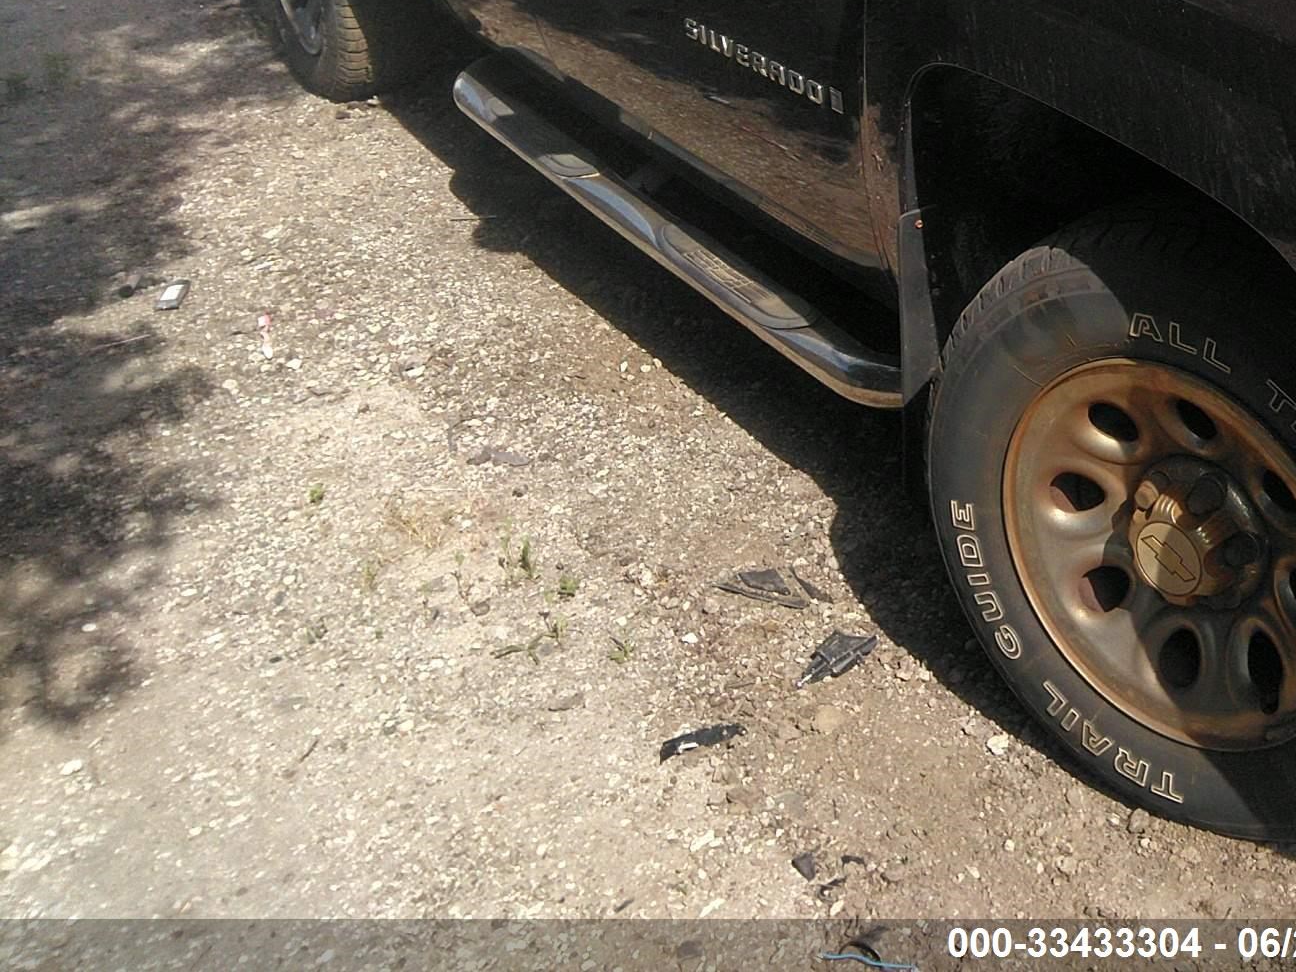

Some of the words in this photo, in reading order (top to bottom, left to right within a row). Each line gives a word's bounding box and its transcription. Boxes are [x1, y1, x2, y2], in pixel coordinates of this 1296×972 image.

[685, 17, 824, 105] SILVERADO
[1129, 312, 1231, 374] ALL
[950, 499, 1022, 660] GUIDE
[1043, 680, 1184, 804] TRAIL
